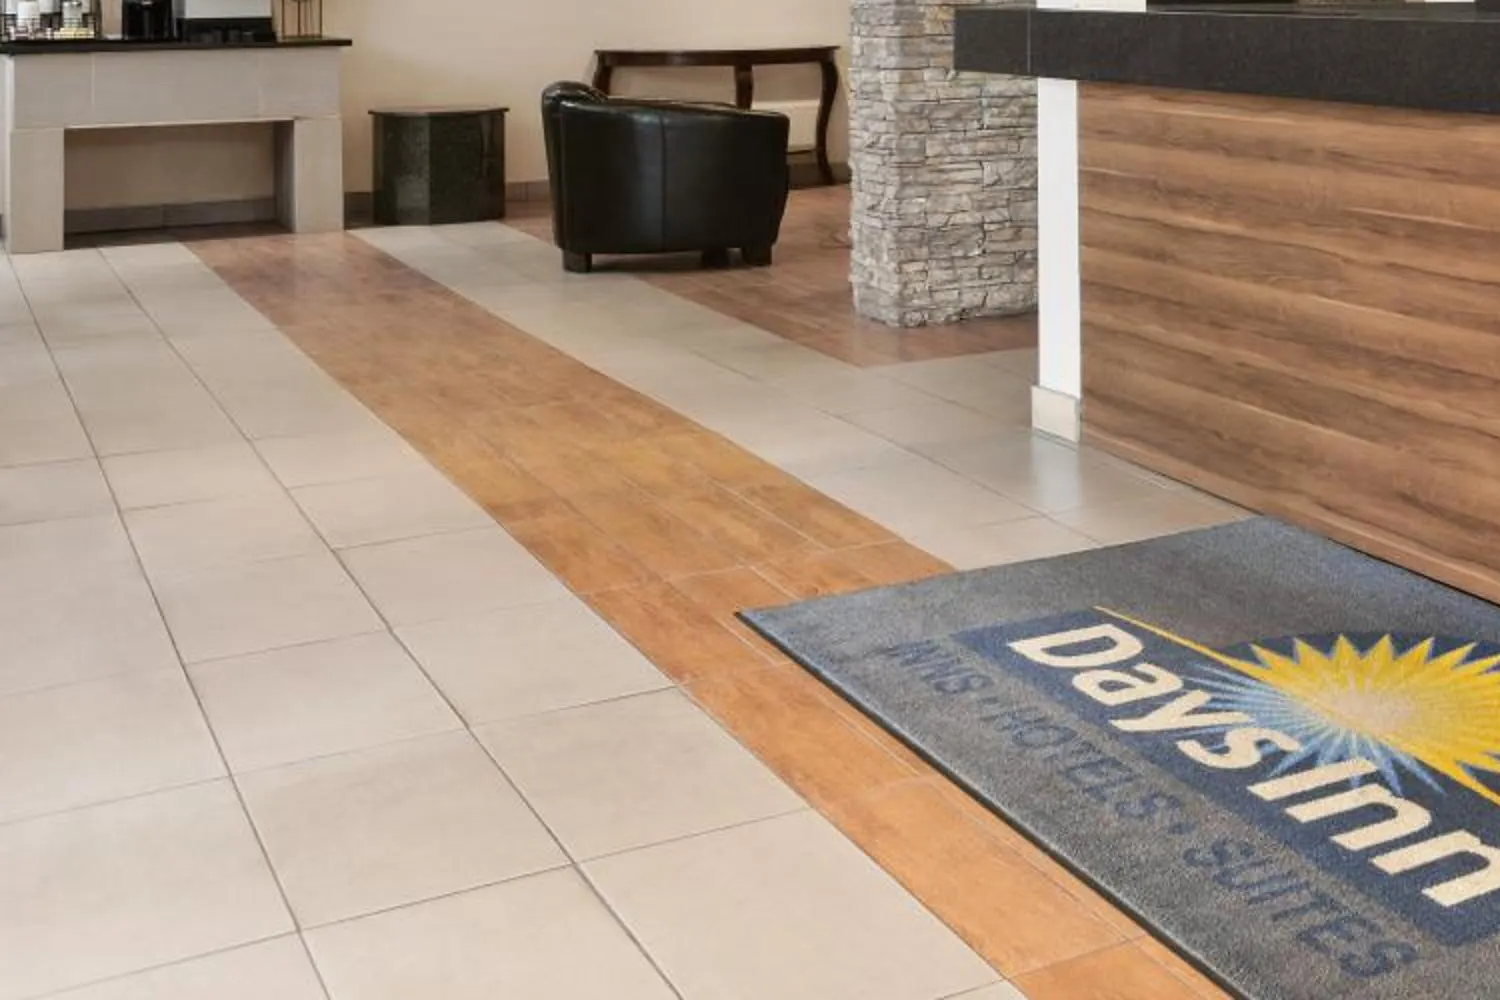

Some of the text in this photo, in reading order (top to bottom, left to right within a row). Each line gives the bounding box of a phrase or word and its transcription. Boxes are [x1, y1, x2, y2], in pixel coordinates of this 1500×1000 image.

[1006, 622, 1300, 770] Days
[978, 704, 1186, 821] HOTELS
[1182, 838, 1420, 978] SUITES
